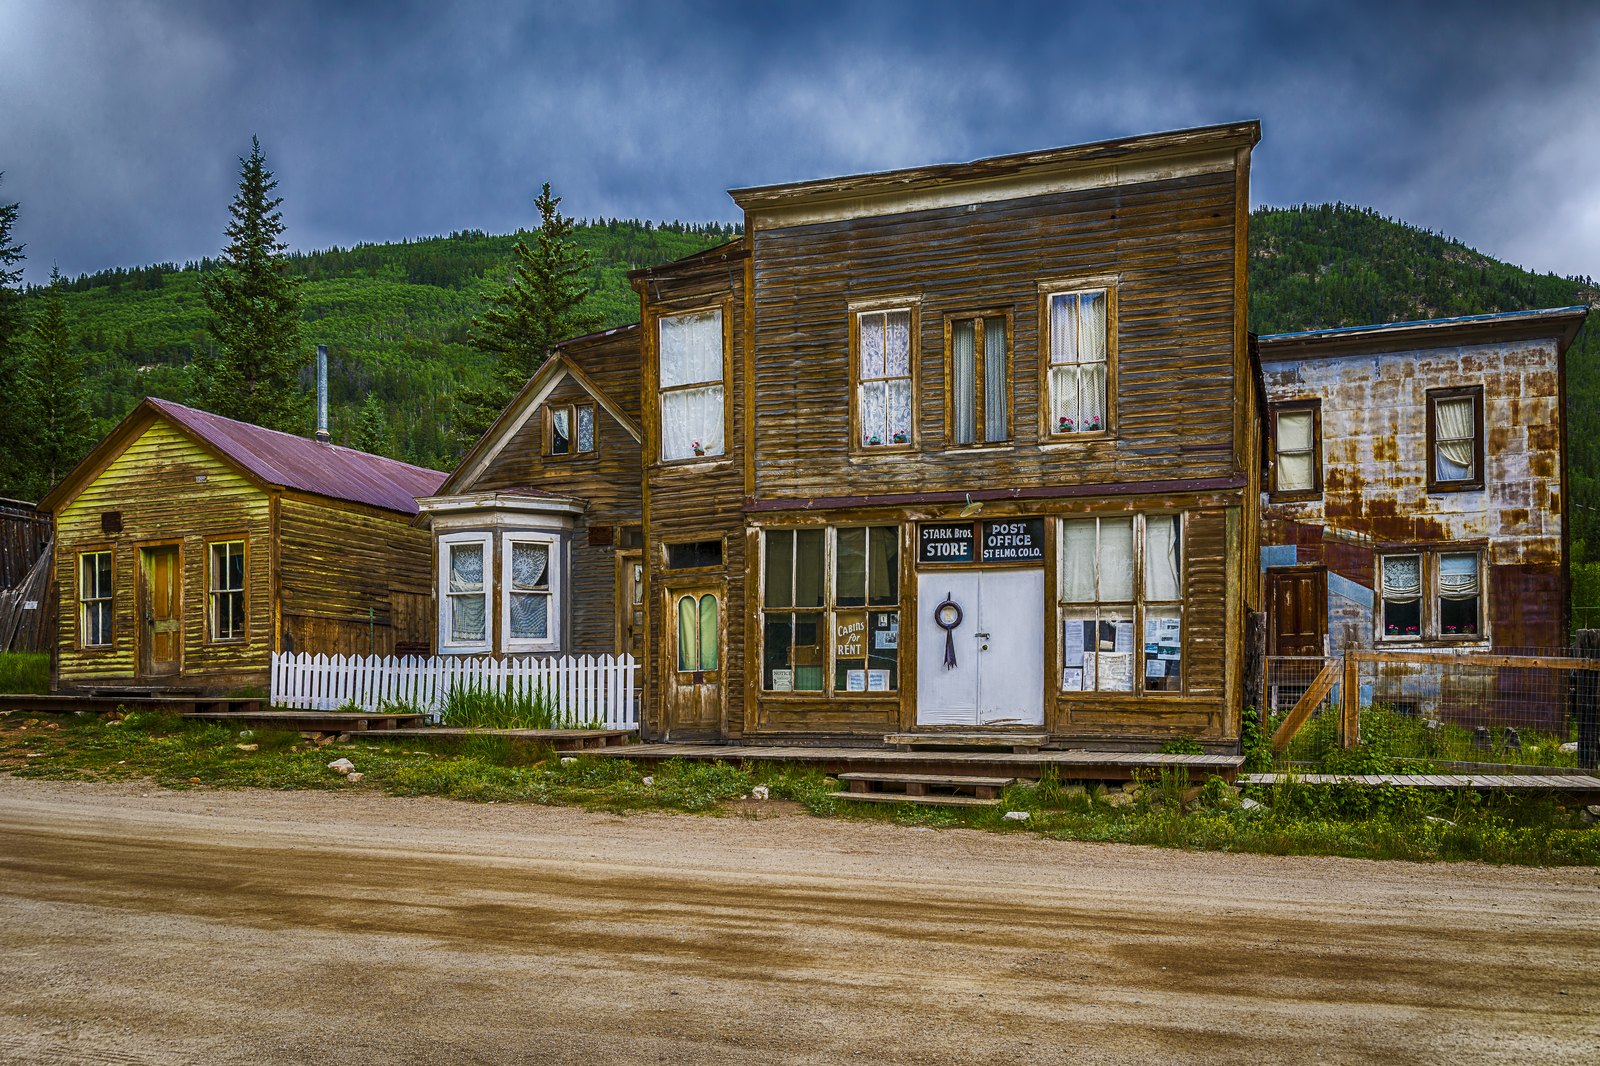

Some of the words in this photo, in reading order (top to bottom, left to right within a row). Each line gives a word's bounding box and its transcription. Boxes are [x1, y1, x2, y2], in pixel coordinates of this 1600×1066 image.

[923, 529, 952, 539] STARK
[954, 528, 973, 538] Bros.
[992, 523, 1026, 535] POST
[988, 534, 1032, 547] OFFICE
[926, 542, 968, 556] STORE
[983, 549, 994, 558] ST
[1018, 547, 1042, 557] COLO.
[846, 633, 861, 645] for
[837, 644, 862, 655] RENT
